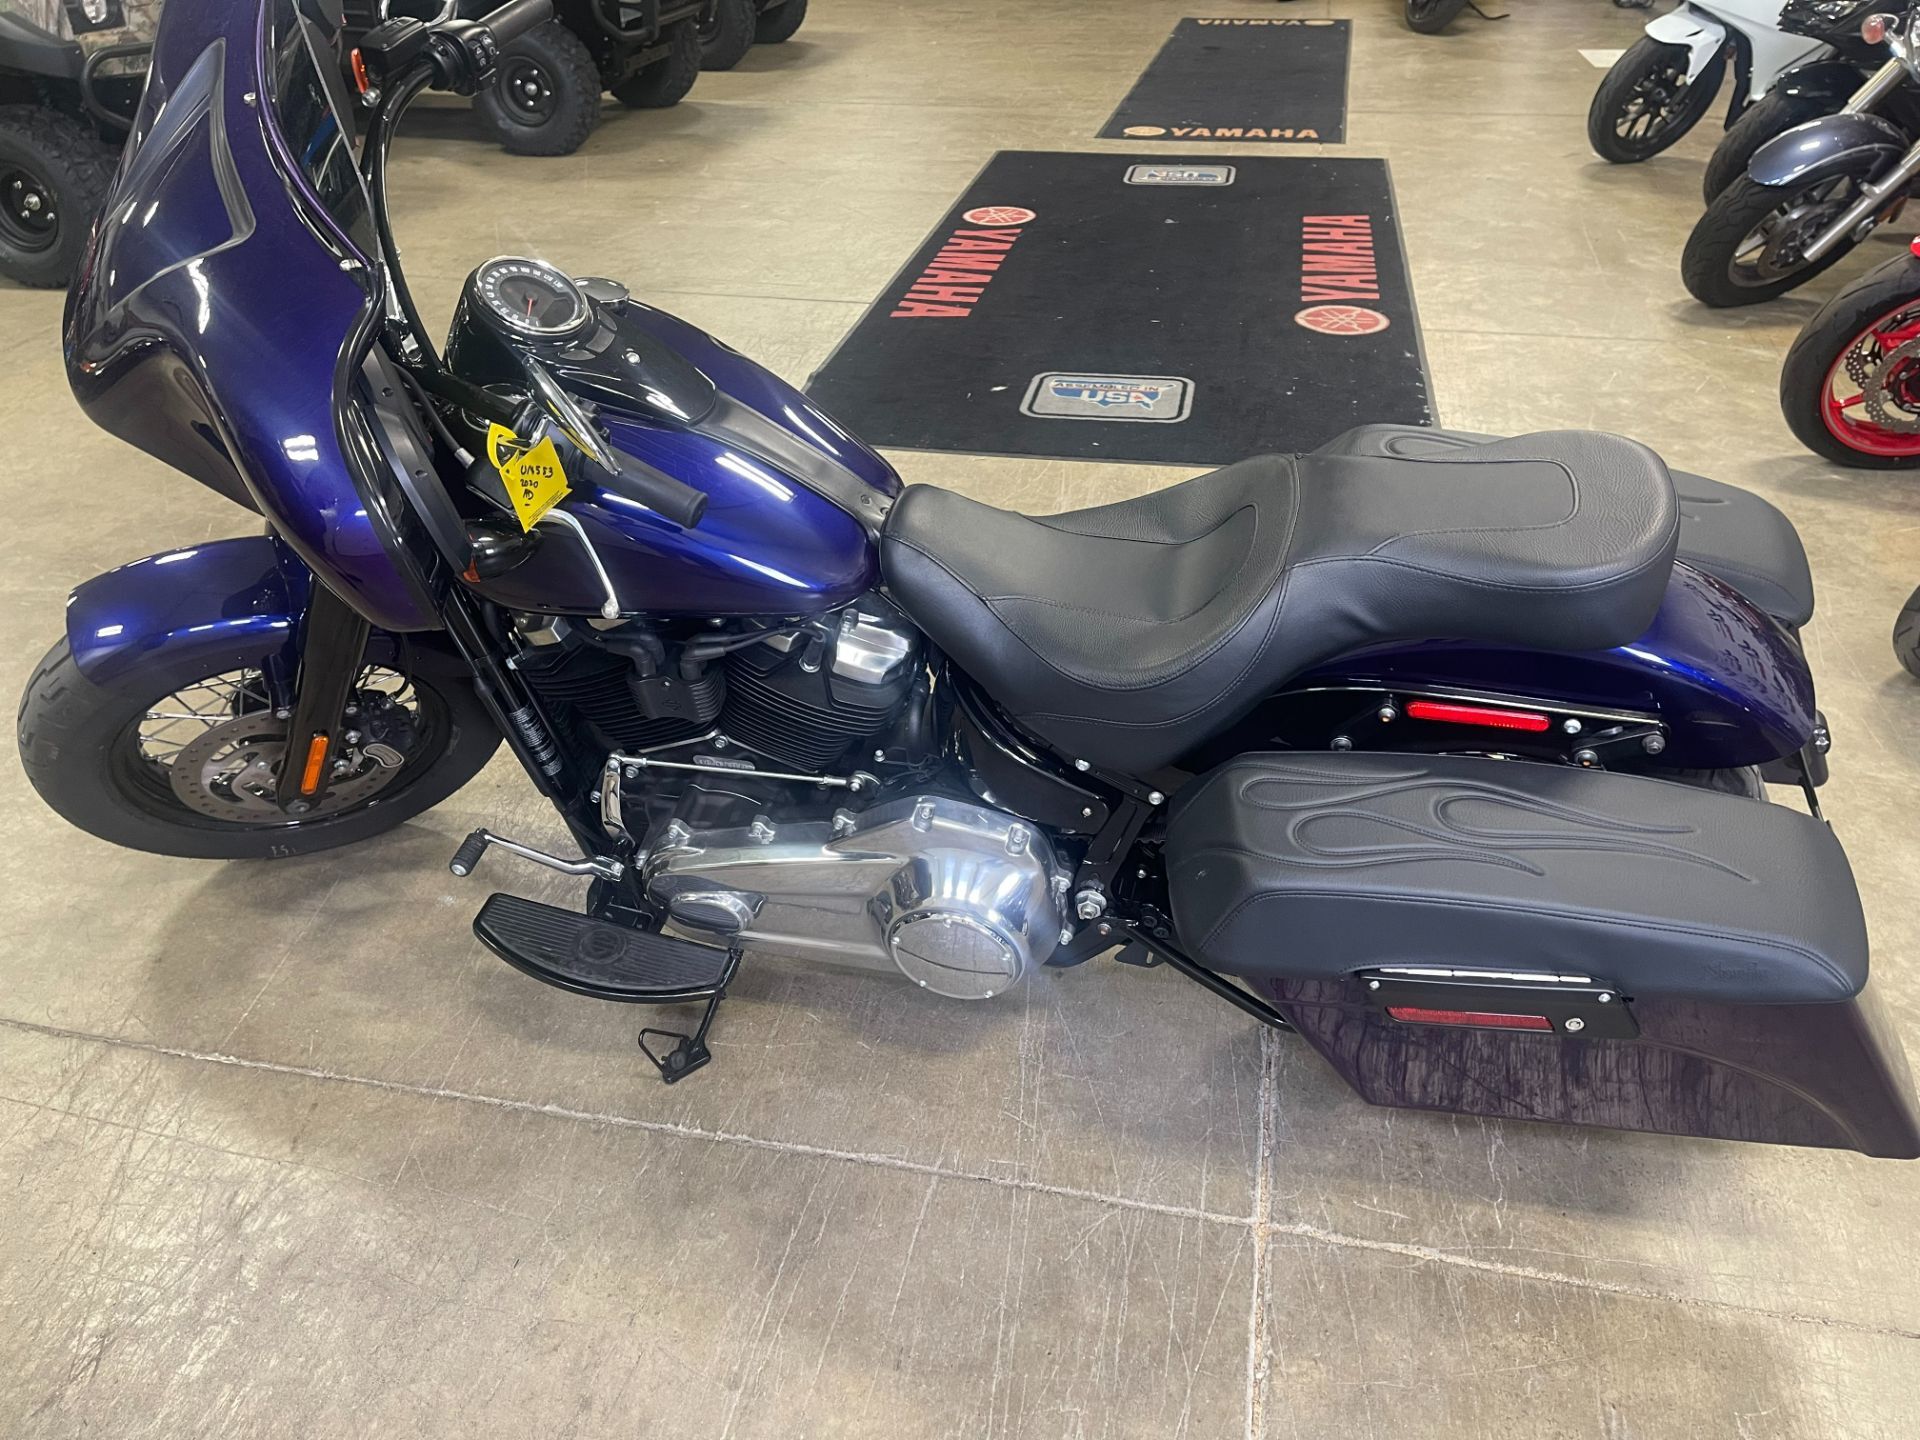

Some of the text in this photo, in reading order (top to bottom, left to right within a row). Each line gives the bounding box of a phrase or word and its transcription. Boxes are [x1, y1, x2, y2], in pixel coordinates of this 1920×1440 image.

[1170, 127, 1319, 138] YAMAHA
[889, 228, 1023, 318] YAMAHA
[1301, 215, 1380, 301] YAMAHA
[1080, 390, 1153, 403] USA
